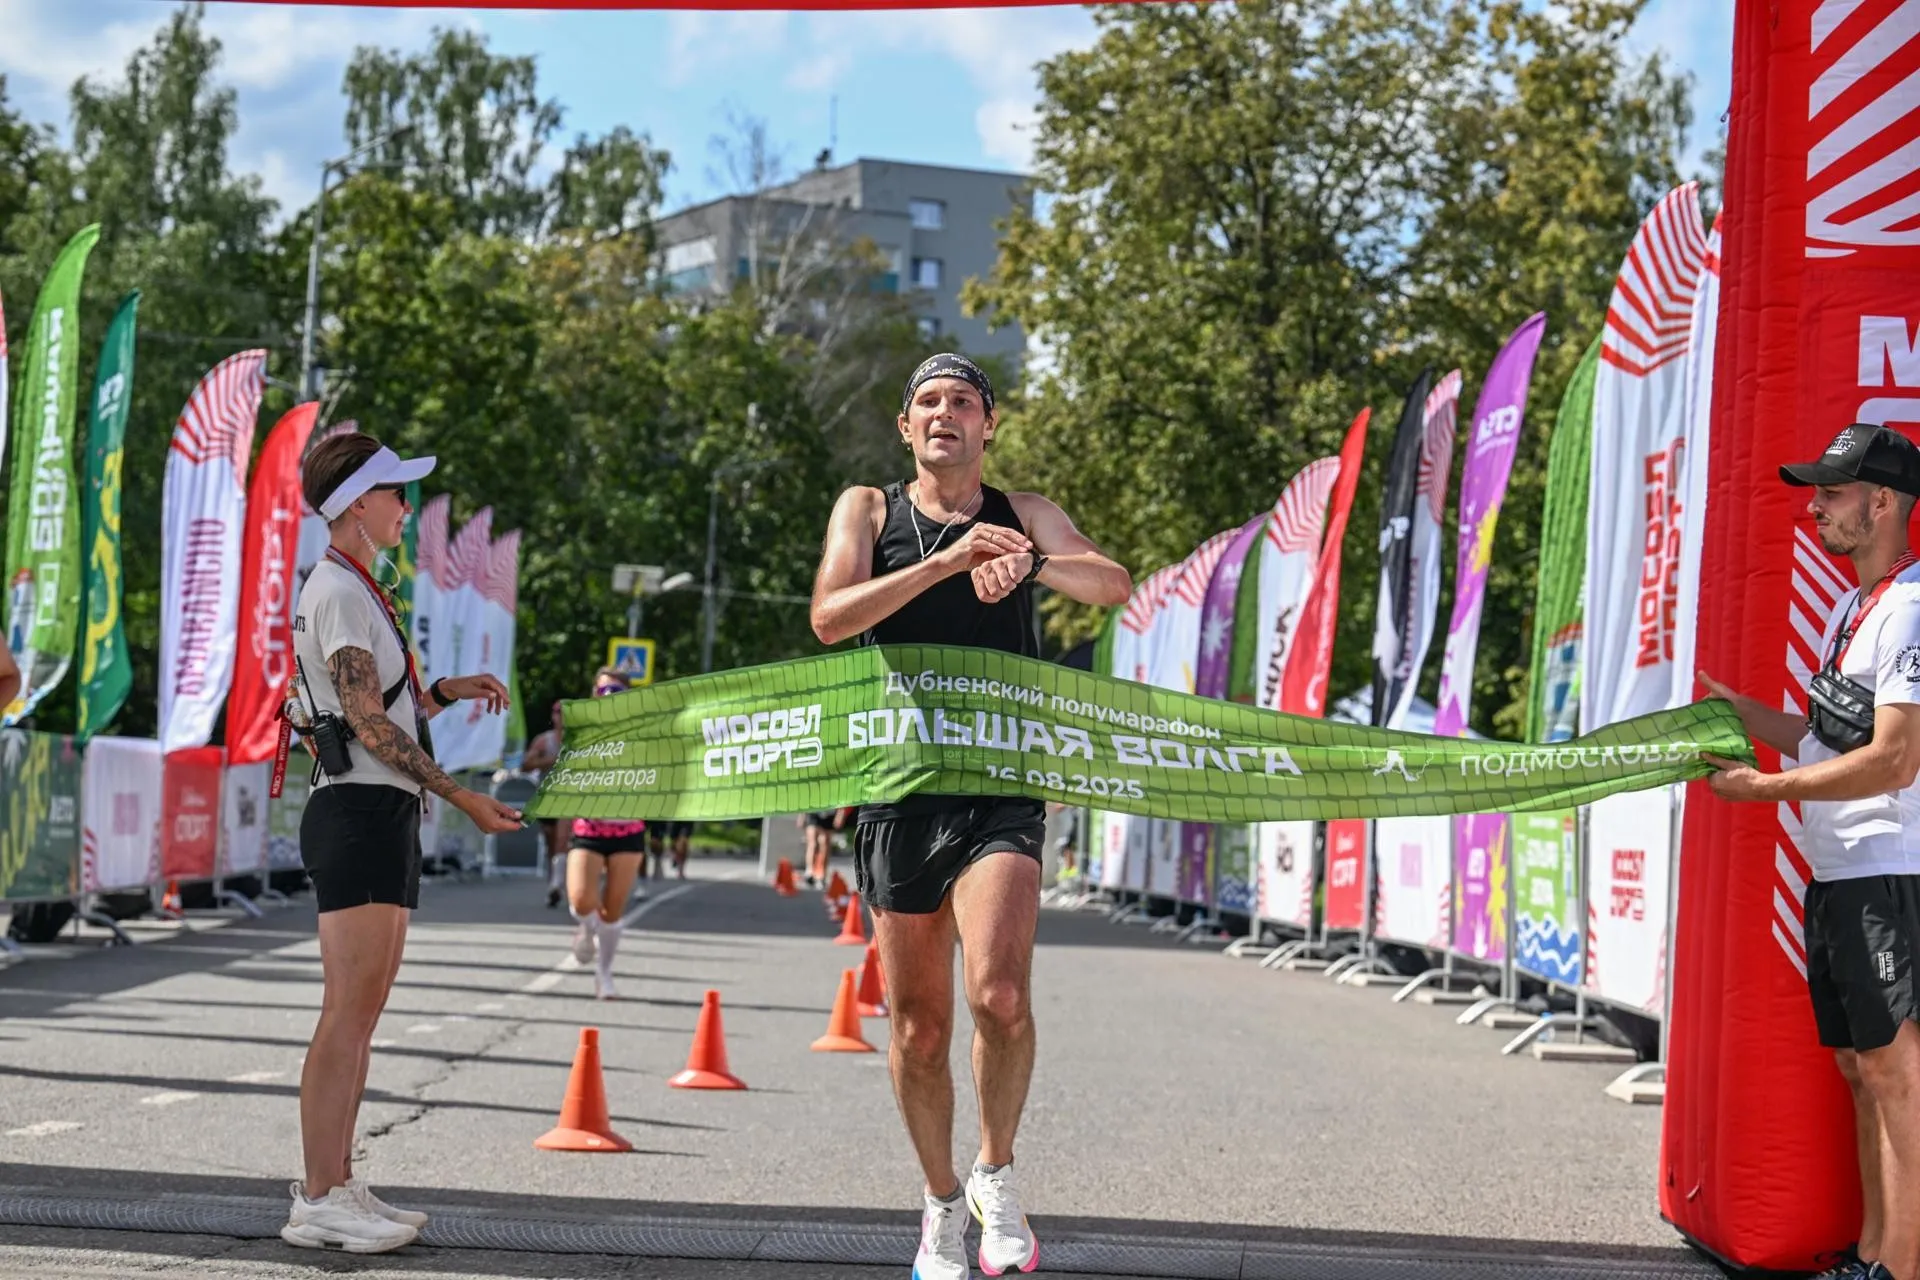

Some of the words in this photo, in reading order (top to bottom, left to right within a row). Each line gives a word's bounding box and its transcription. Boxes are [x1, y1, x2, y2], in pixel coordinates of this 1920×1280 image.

[702, 704, 822, 746] МОСОБЛ
[886, 669, 1043, 707] Дубненский
[1051, 696, 1222, 741] полумарафон
[704, 737, 822, 777] СПОРТ
[849, 708, 1094, 760] БОЛЬШАЯ
[1111, 734, 1302, 776] ВОЛГА
